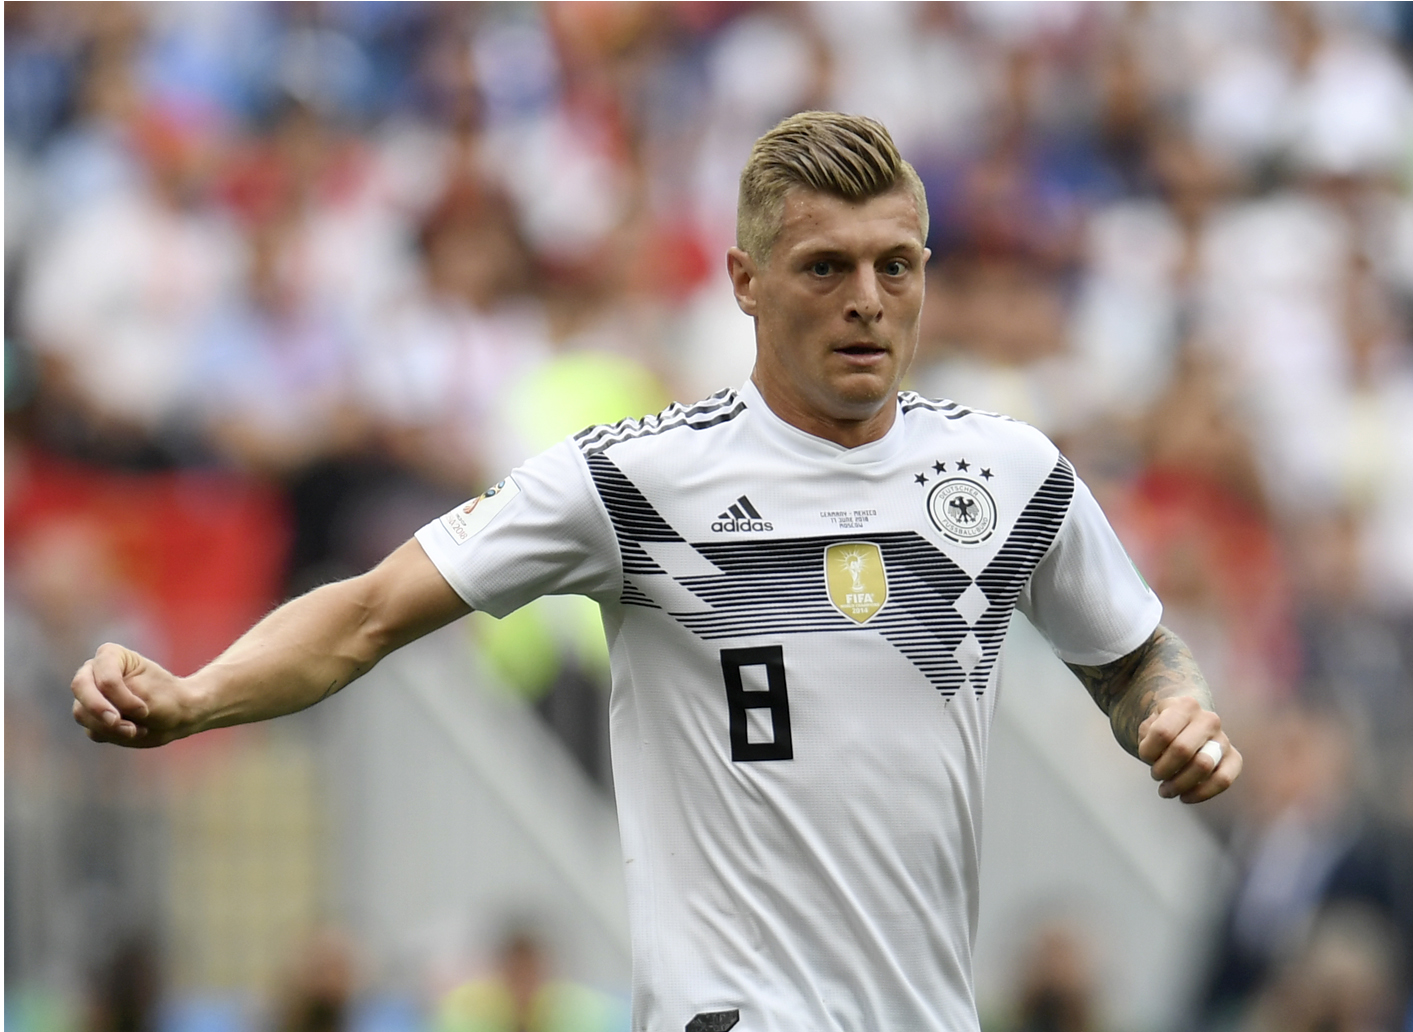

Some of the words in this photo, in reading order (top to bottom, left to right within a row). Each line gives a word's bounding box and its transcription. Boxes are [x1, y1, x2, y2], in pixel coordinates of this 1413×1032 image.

[711, 518, 774, 533] adidas
[845, 593, 873, 604] FIFA
[720, 644, 794, 762] 8
